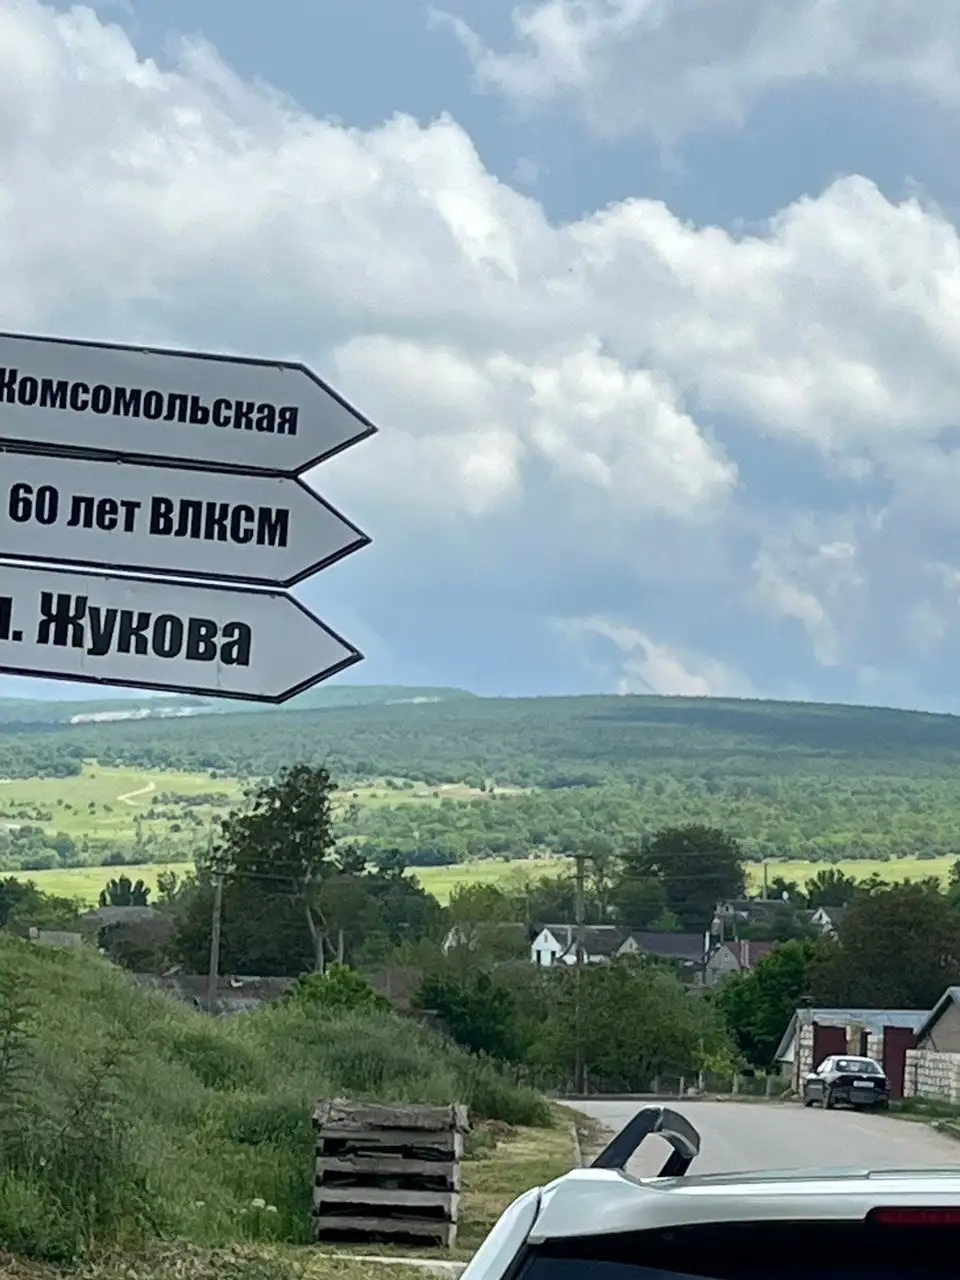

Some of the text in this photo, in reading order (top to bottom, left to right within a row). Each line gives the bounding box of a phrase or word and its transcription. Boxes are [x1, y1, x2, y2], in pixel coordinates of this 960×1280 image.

[0, 367, 299, 435] Комсомольская
[8, 482, 290, 547] 60 лет ВЛКСМ
[36, 591, 252, 667] Жукова
